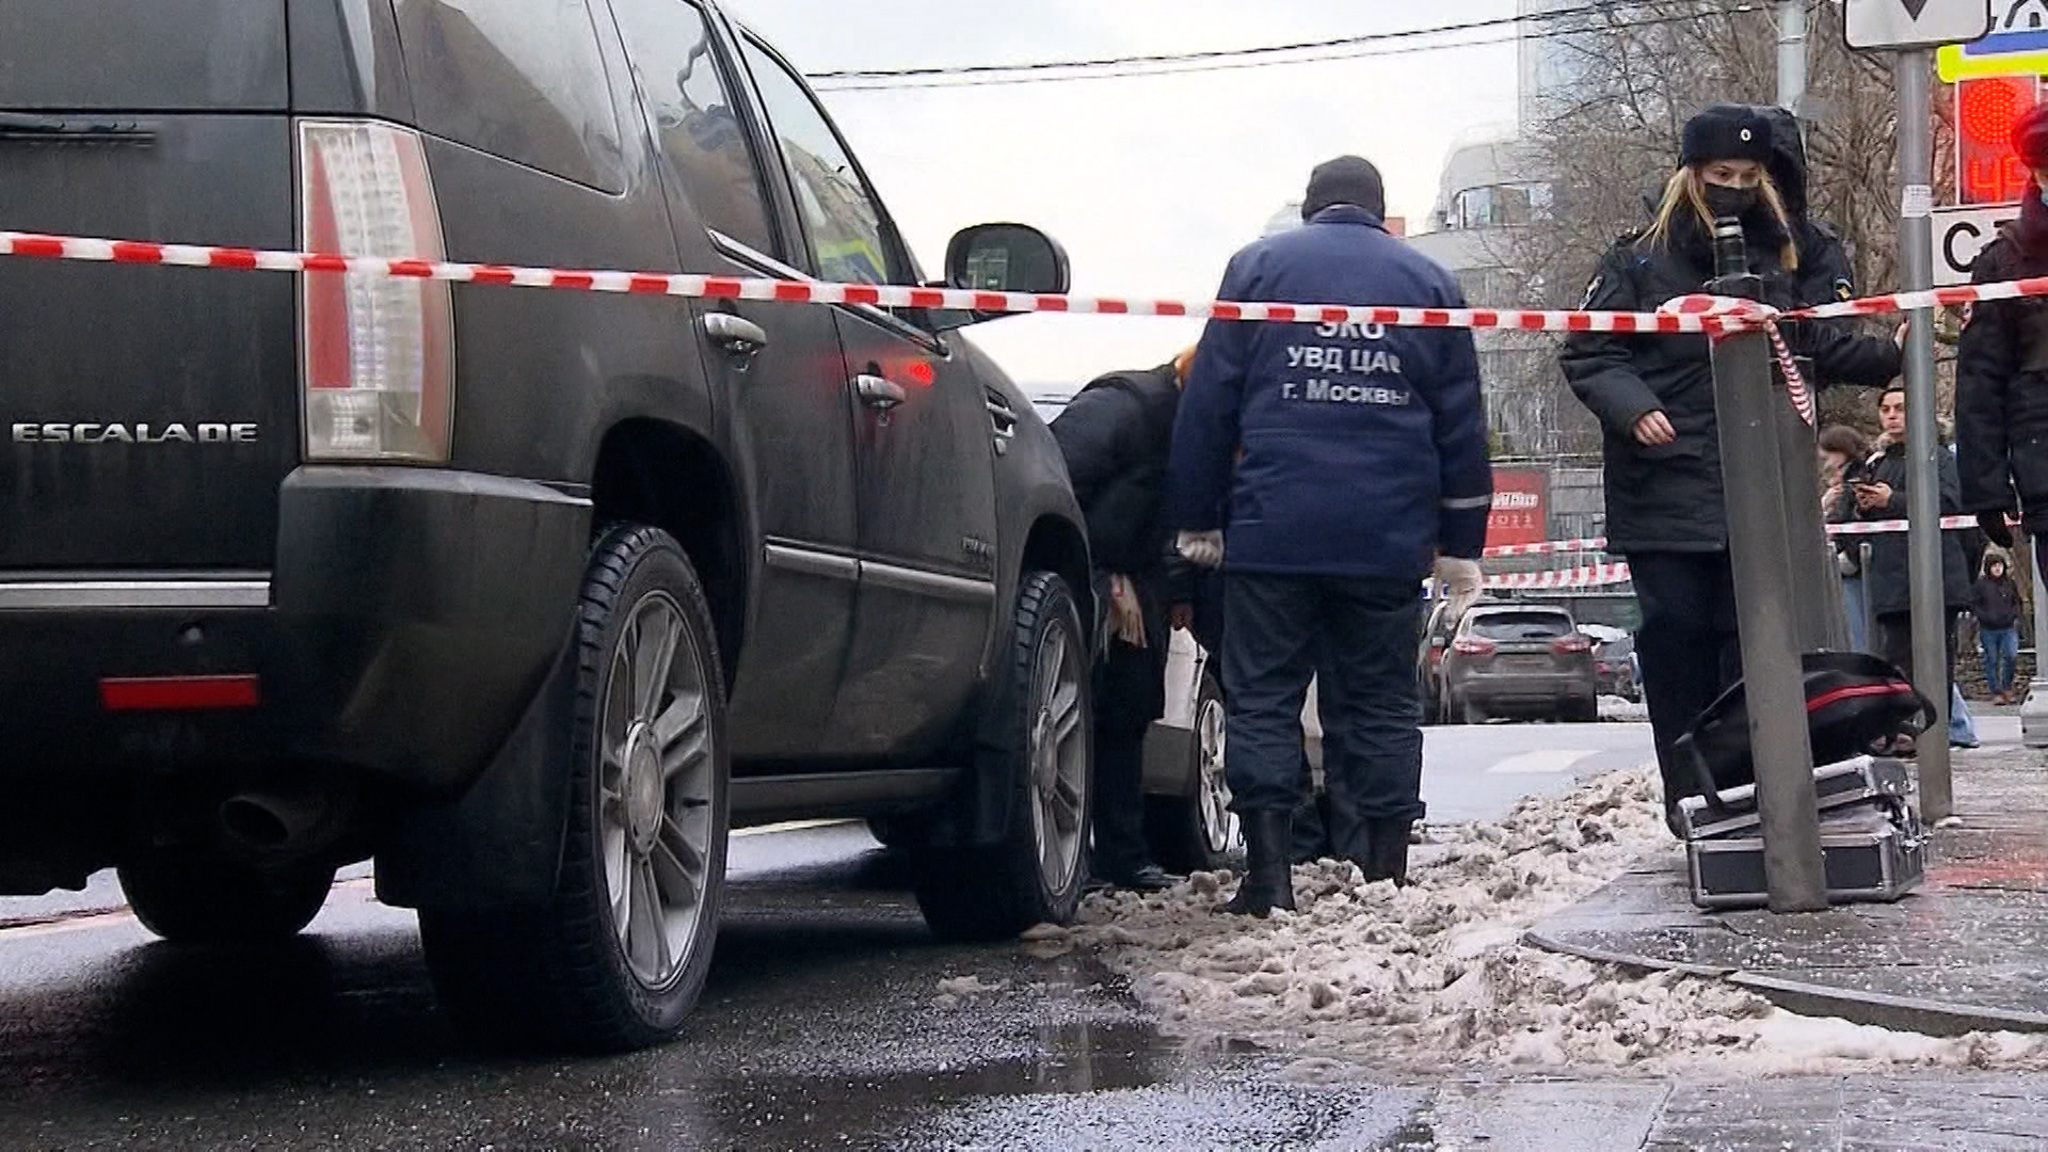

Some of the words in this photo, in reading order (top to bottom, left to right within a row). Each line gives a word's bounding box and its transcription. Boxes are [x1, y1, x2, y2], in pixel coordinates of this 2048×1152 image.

[1287, 346, 1343, 373] УВД
[1282, 383, 1298, 399] г.
[1306, 379, 1410, 405] Москвы
[12, 423, 258, 442] ESCALADE
